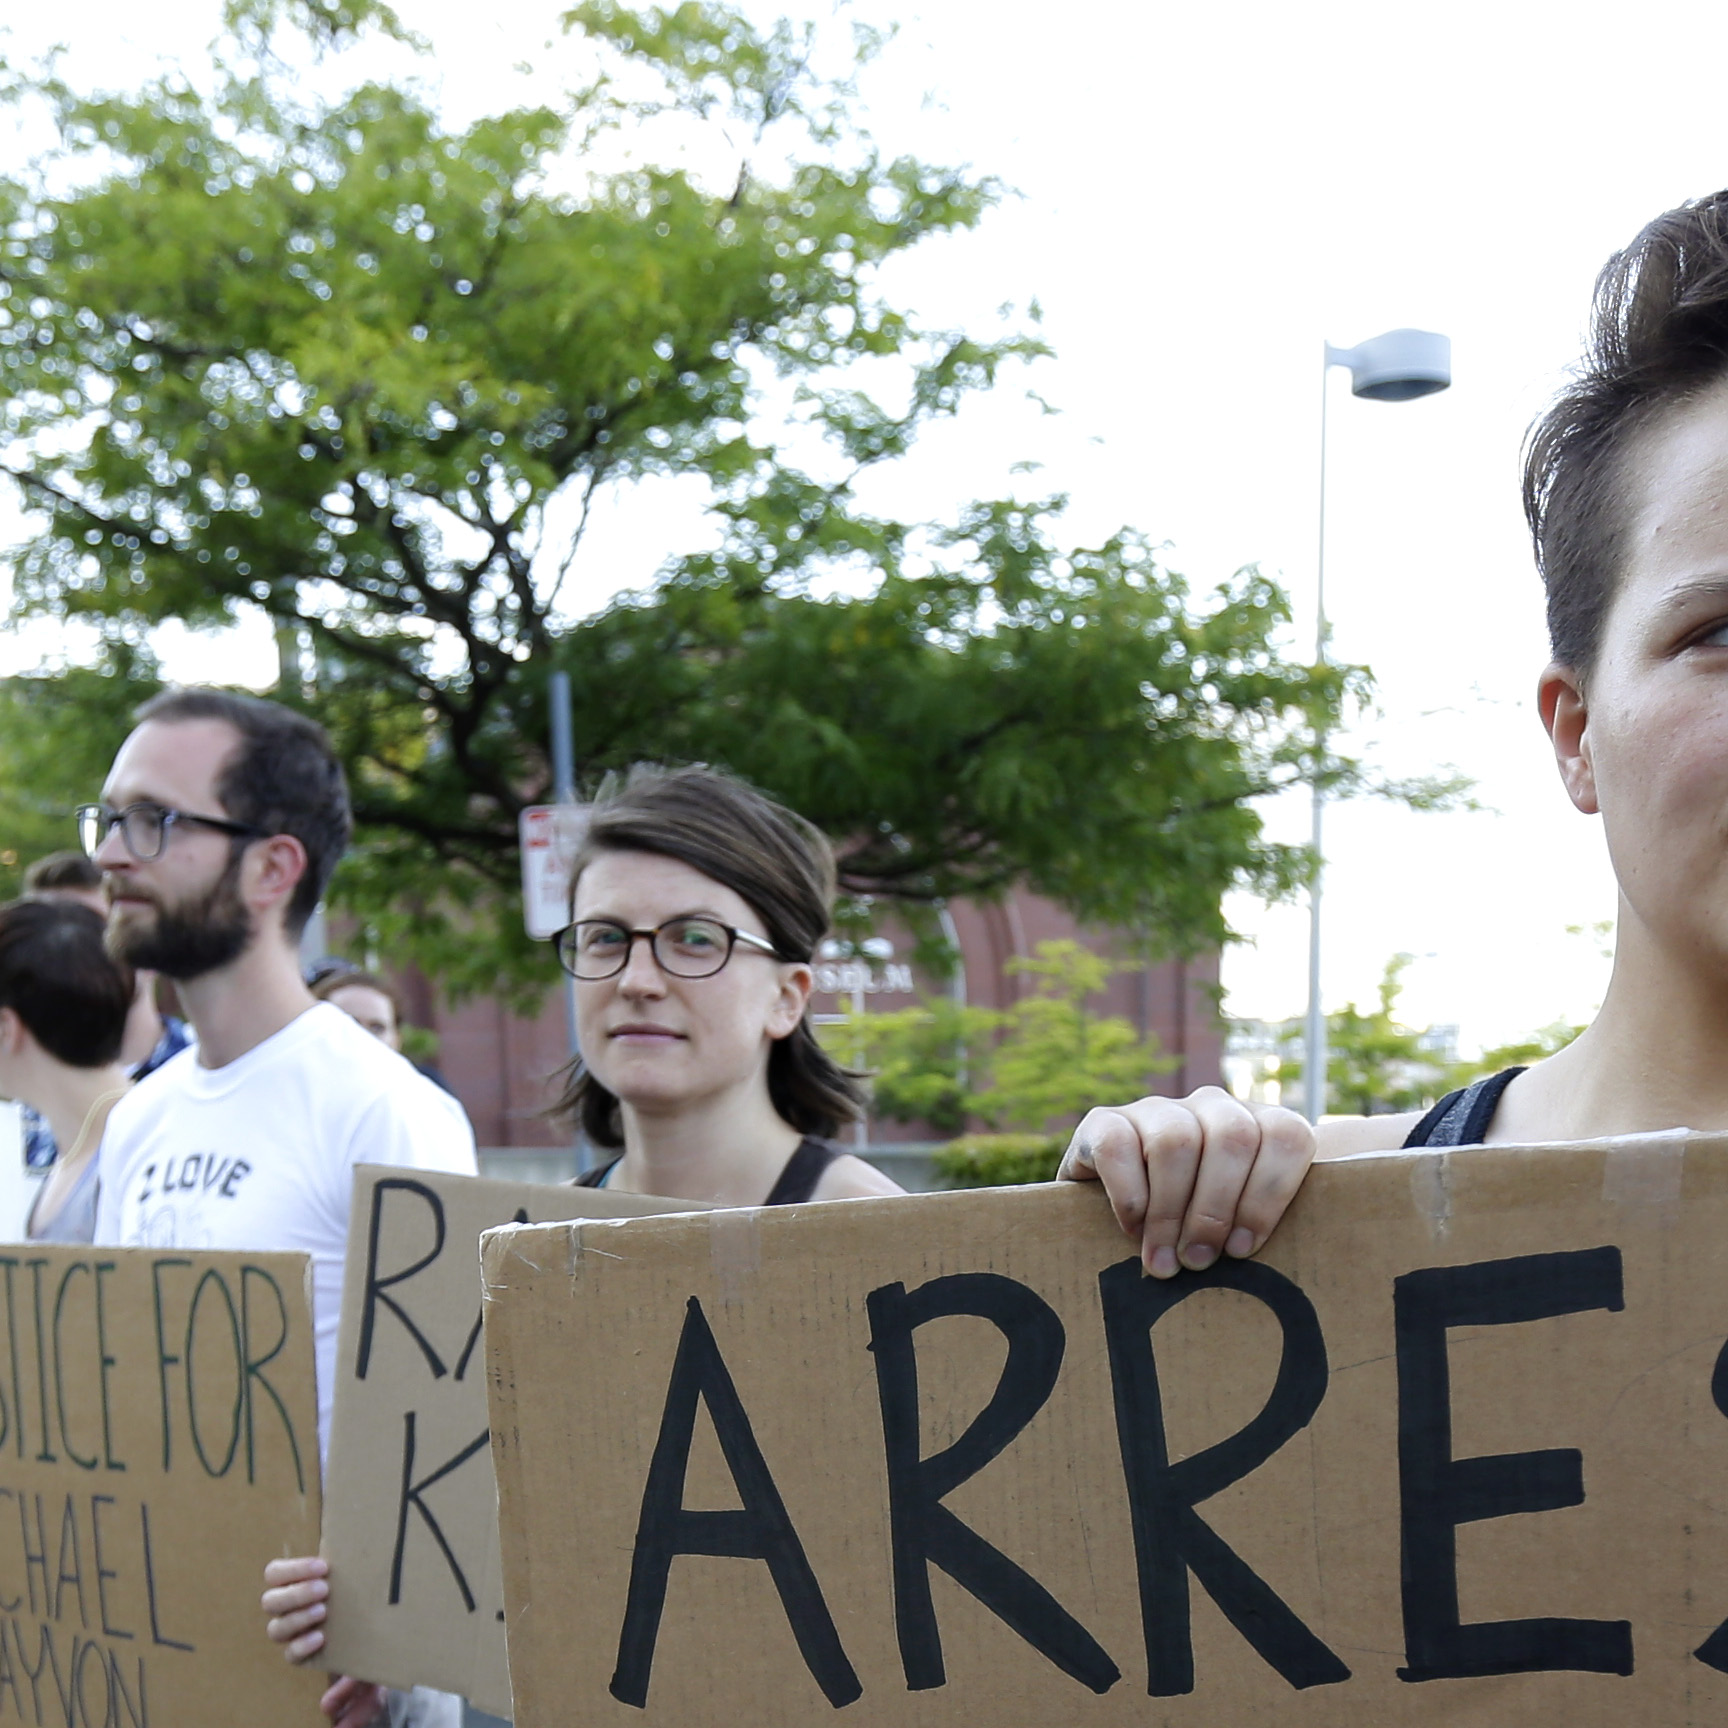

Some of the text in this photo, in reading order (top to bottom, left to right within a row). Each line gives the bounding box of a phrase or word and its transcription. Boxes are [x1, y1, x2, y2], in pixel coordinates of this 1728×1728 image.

[139, 1154, 251, 1202] I LOVE
[153, 1259, 306, 1495] FOR
